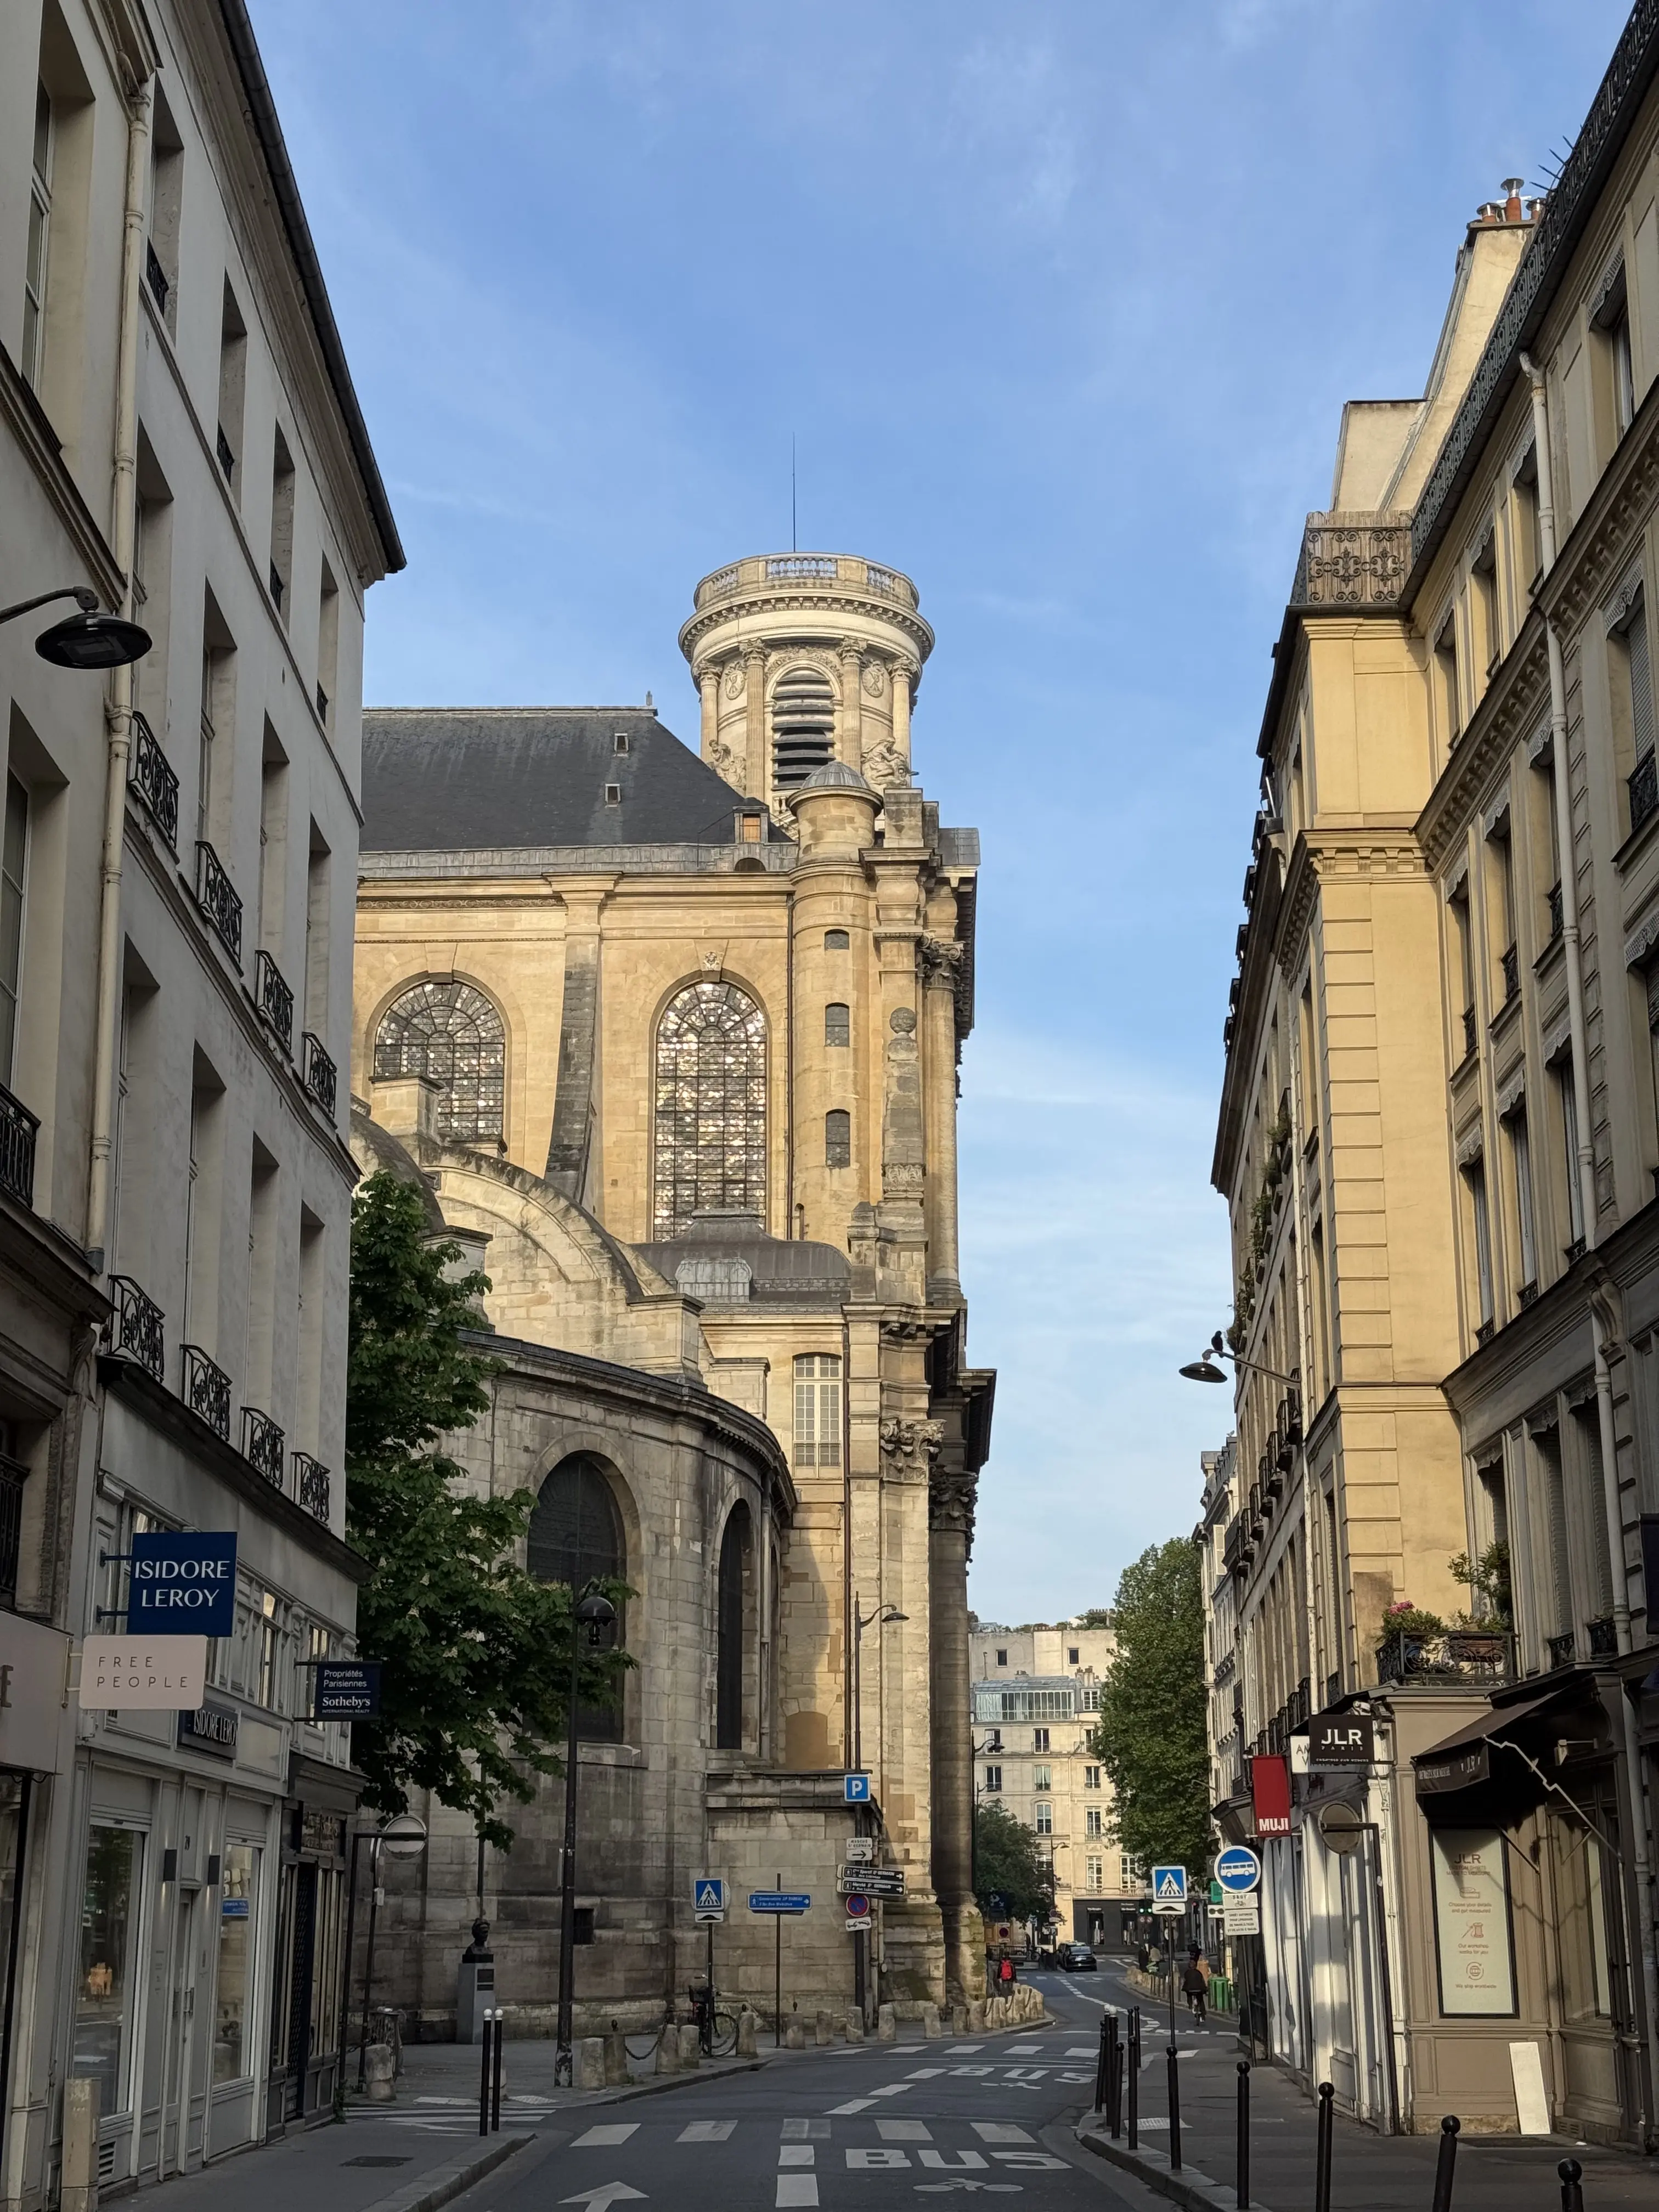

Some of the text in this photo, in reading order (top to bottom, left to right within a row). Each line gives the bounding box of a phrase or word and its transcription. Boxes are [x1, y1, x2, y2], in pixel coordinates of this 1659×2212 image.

[135, 1560, 230, 1579] ISIDORE
[142, 1589, 219, 1607] LEROY
[99, 1656, 154, 1667] FREE
[324, 1669, 363, 1679] Propriétés
[97, 1677, 188, 1688] PEOPLE
[323, 1679, 368, 1688] Parisiennes
[322, 1696, 371, 1709] Sotheby's
[194, 1709, 219, 1740] ISIDORE
[1321, 1728, 1363, 1745] JLR
[851, 1780, 862, 1796] P
[1259, 1818, 1289, 1832] MUJI
[1454, 1853, 1481, 1864] JLR
[948, 2067, 1097, 2084] BUS
[845, 2148, 1073, 2170] BUS
